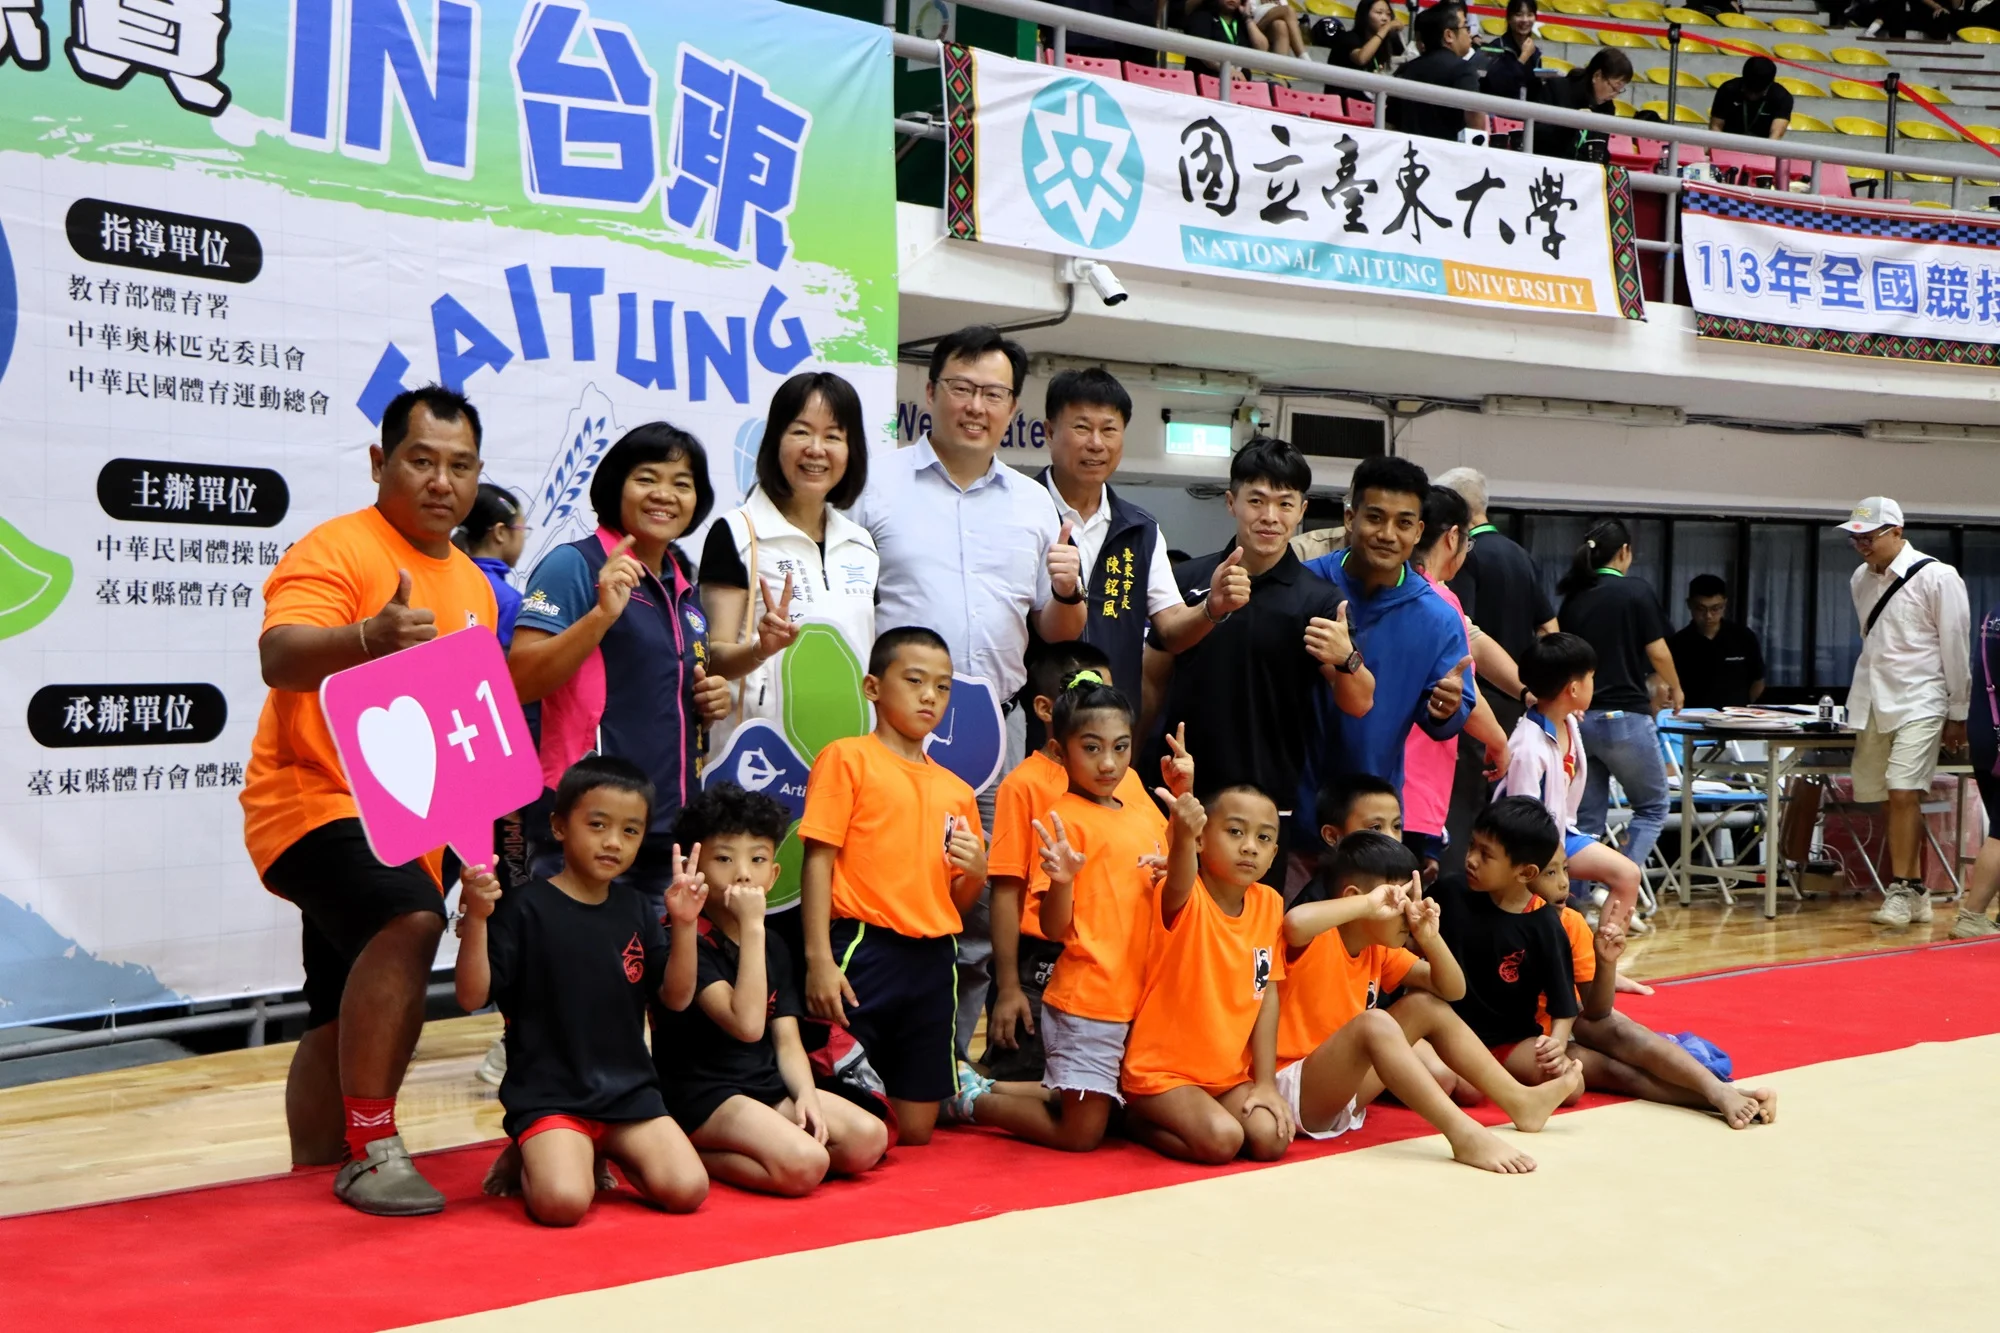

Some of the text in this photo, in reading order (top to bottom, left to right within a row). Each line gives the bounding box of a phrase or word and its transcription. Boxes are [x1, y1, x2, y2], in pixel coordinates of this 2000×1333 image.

[288, 0, 476, 174] IN
[514, 2, 810, 272] 台東
[1178, 115, 1578, 260] 國立臺東大學
[101, 211, 231, 268] 指導單位
[68, 274, 229, 320] 教育部體育署
[1190, 234, 1585, 306] NATIONAL TAITUNG UNIVERSITY
[68, 320, 305, 372] 中華奧林匹克委員會
[68, 366, 330, 415] 中華民國體育運動總會
[131, 470, 258, 515] 主辦單位
[97, 535, 295, 566] 中華民國體操協
[96, 578, 253, 608] 臺東縣體育會
[1102, 555, 1122, 619] 陳銘風
[1121, 547, 1135, 610] 臺東市長
[63, 694, 194, 734] 承辦單位
